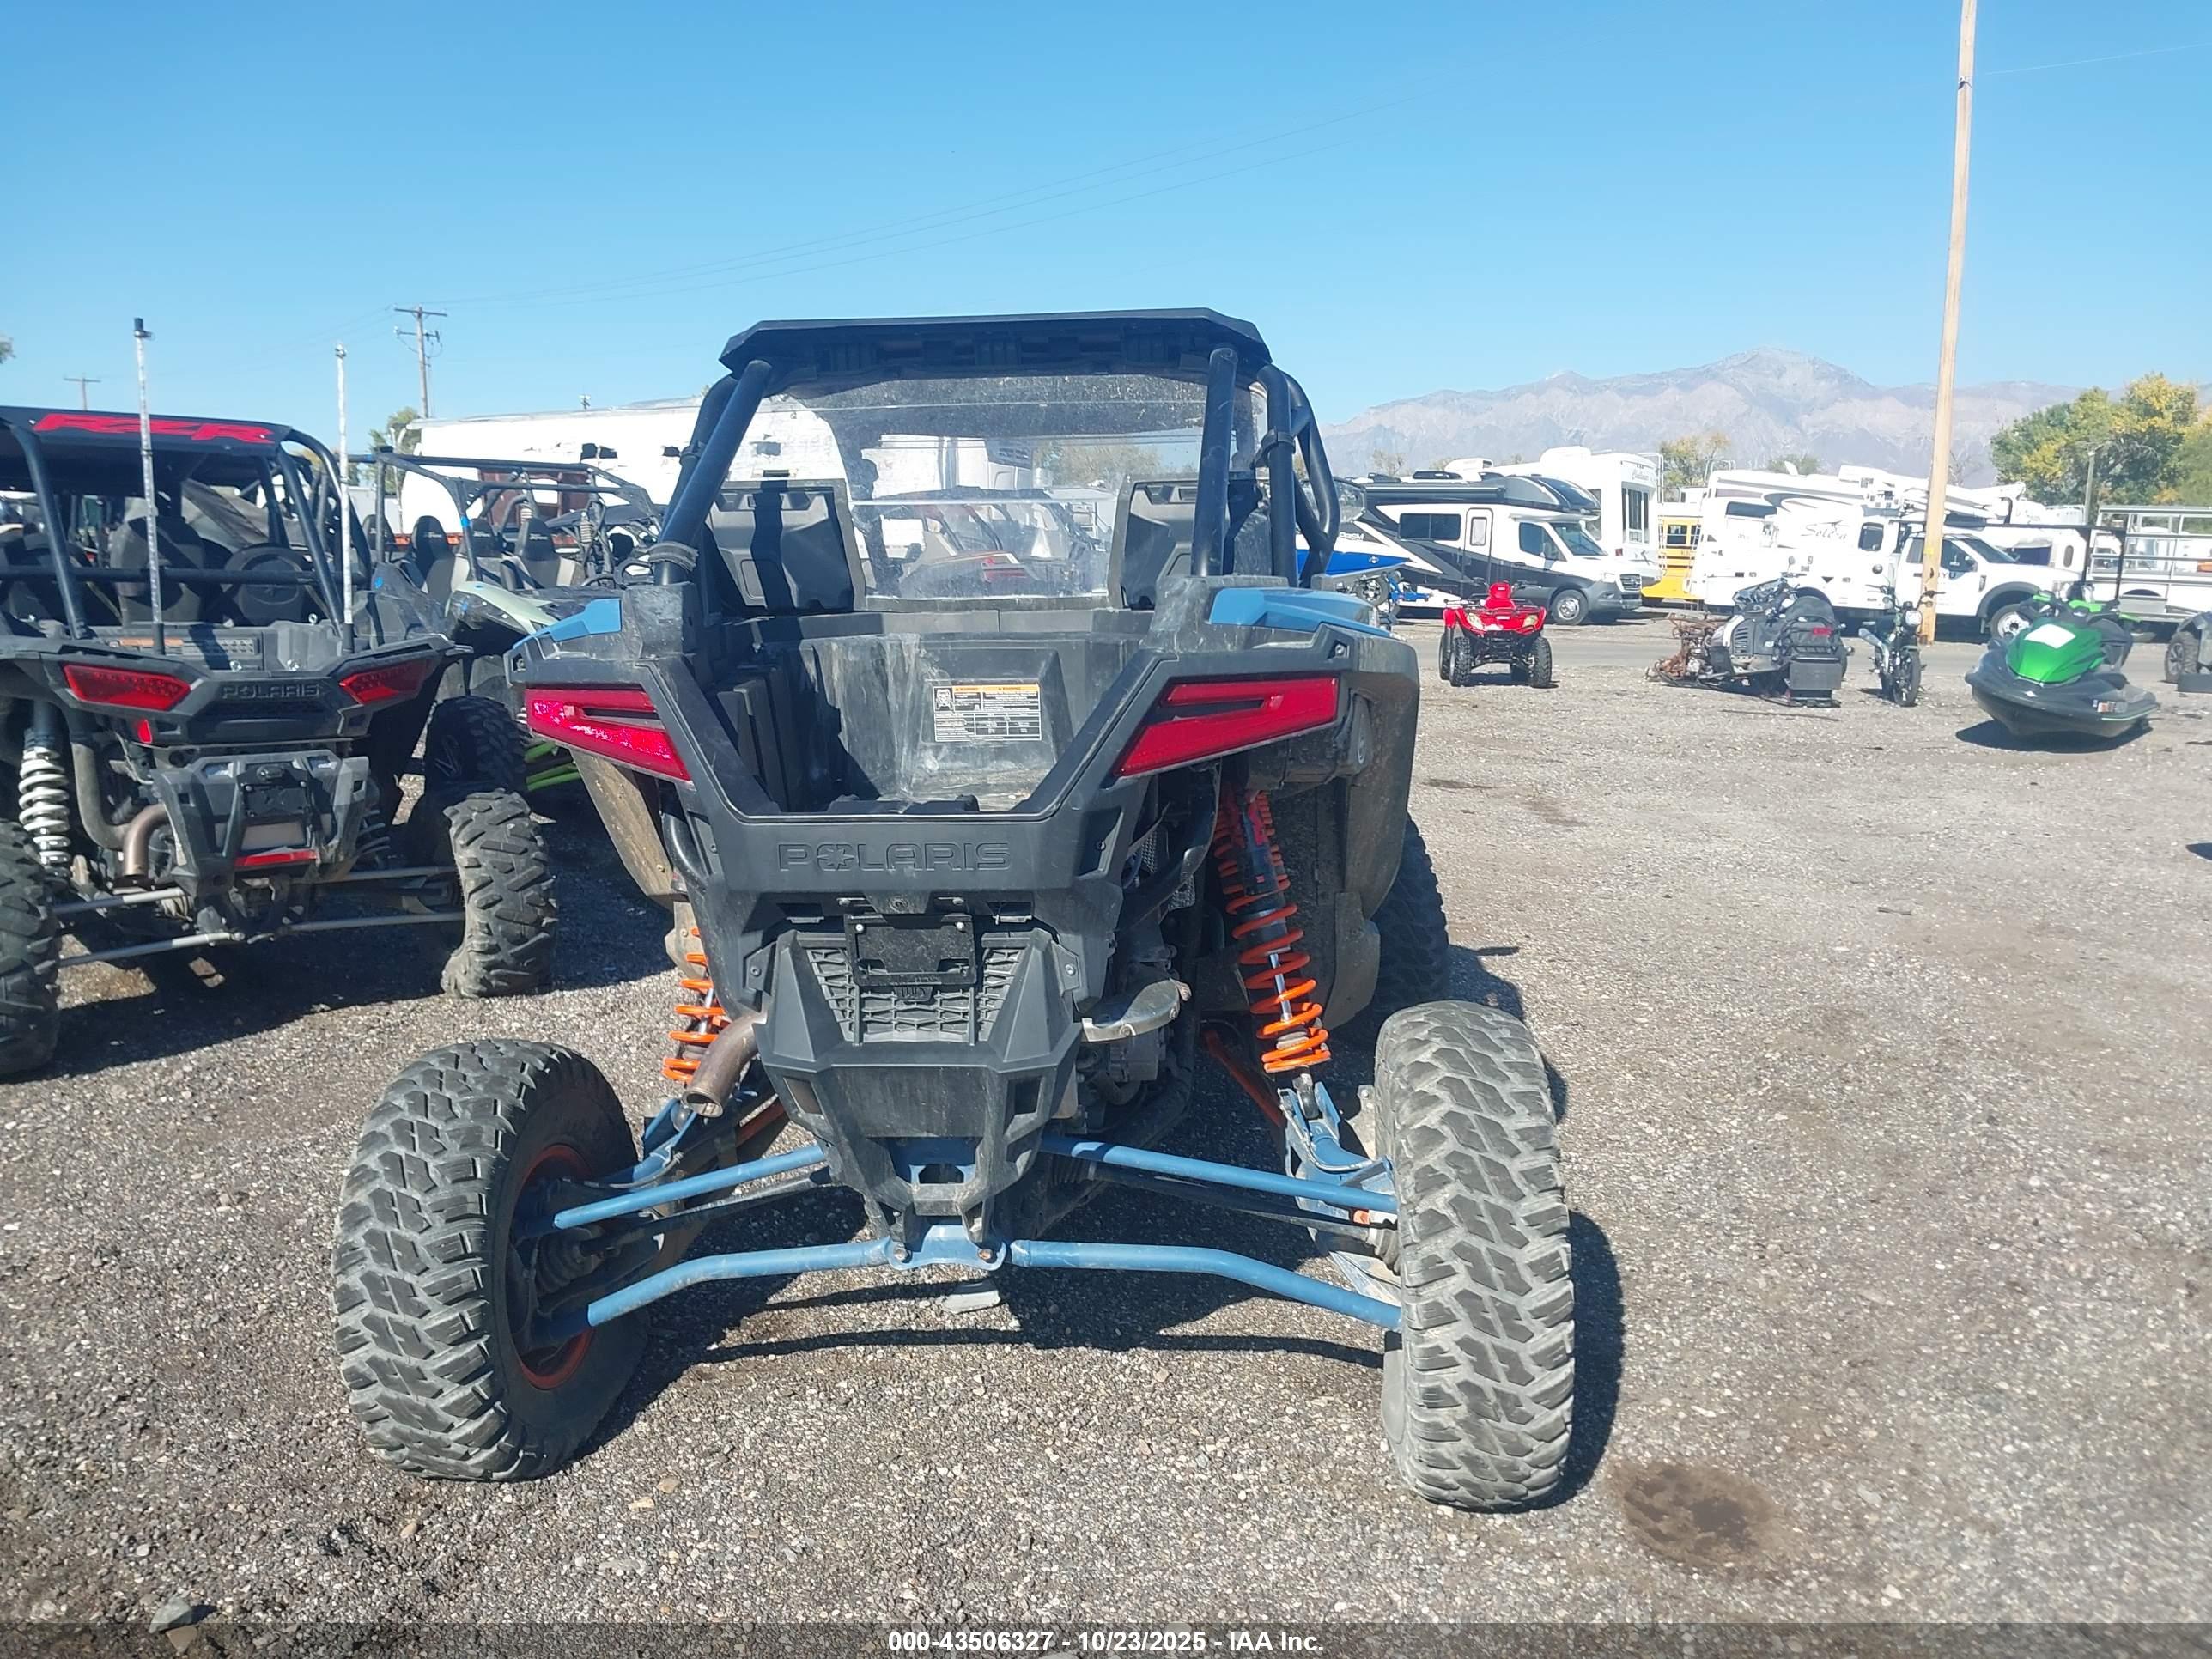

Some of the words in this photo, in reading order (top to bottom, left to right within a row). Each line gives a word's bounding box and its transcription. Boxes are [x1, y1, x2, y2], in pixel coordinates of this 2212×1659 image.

[33, 413, 275, 444] RZR
[222, 684, 320, 699] POLARIS
[777, 842, 1012, 872] POLARIS
